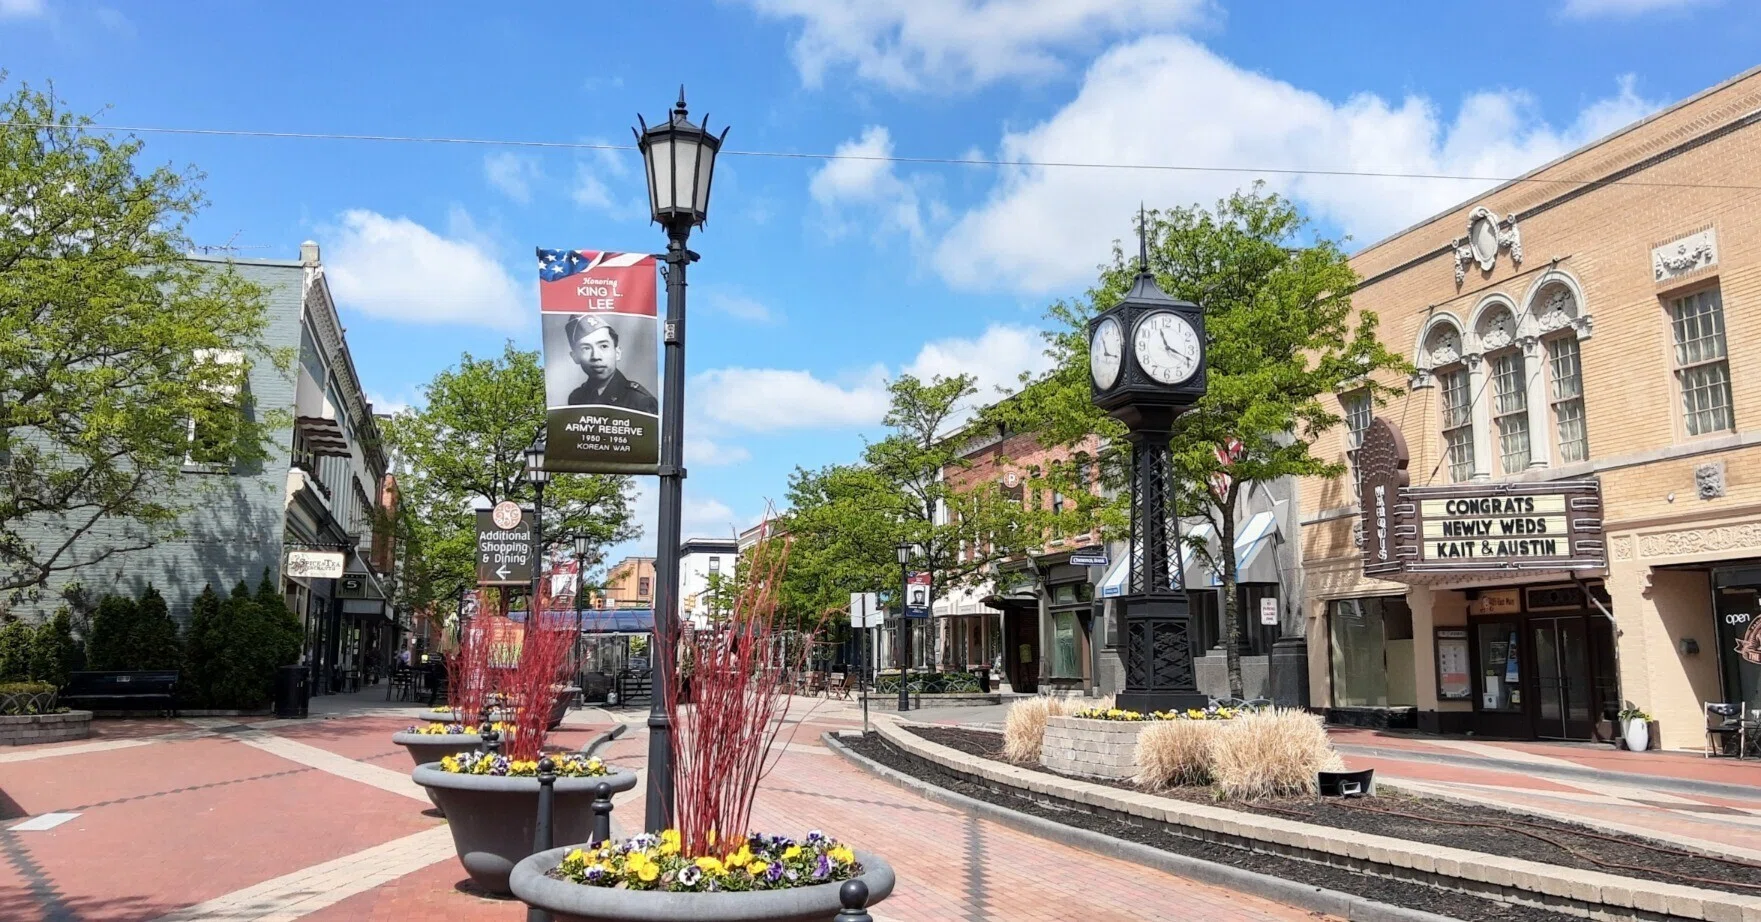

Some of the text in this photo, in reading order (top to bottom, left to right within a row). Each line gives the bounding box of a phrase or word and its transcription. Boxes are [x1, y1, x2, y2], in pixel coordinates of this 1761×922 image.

[583, 278, 618, 287] Honoring
[577, 287, 623, 297] KING L.
[589, 299, 615, 309] LEE
[1162, 318, 1171, 328] 12
[1185, 332, 1191, 342] 2
[1139, 341, 1146, 351] 9
[1188, 345, 1195, 356] 3
[1143, 355, 1150, 365] 8
[1151, 365, 1158, 375] 7
[1164, 368, 1171, 379] 6
[1176, 367, 1183, 377] 5
[579, 416, 609, 424] ARMY
[565, 424, 643, 436] ARMY RESERVE
[577, 443, 610, 451] KOREAN
[1008, 473, 1015, 484] P
[1446, 497, 1534, 515] CONGRATS
[1375, 485, 1388, 560] MARQUIS
[1443, 518, 1546, 536] NEWLY WEDS
[480, 531, 531, 541] Additional
[481, 542, 528, 554] Shopping
[1437, 539, 1556, 558] KAIT & AUSTIN
[482, 553, 526, 565] & Dining
[1726, 613, 1750, 625] open
